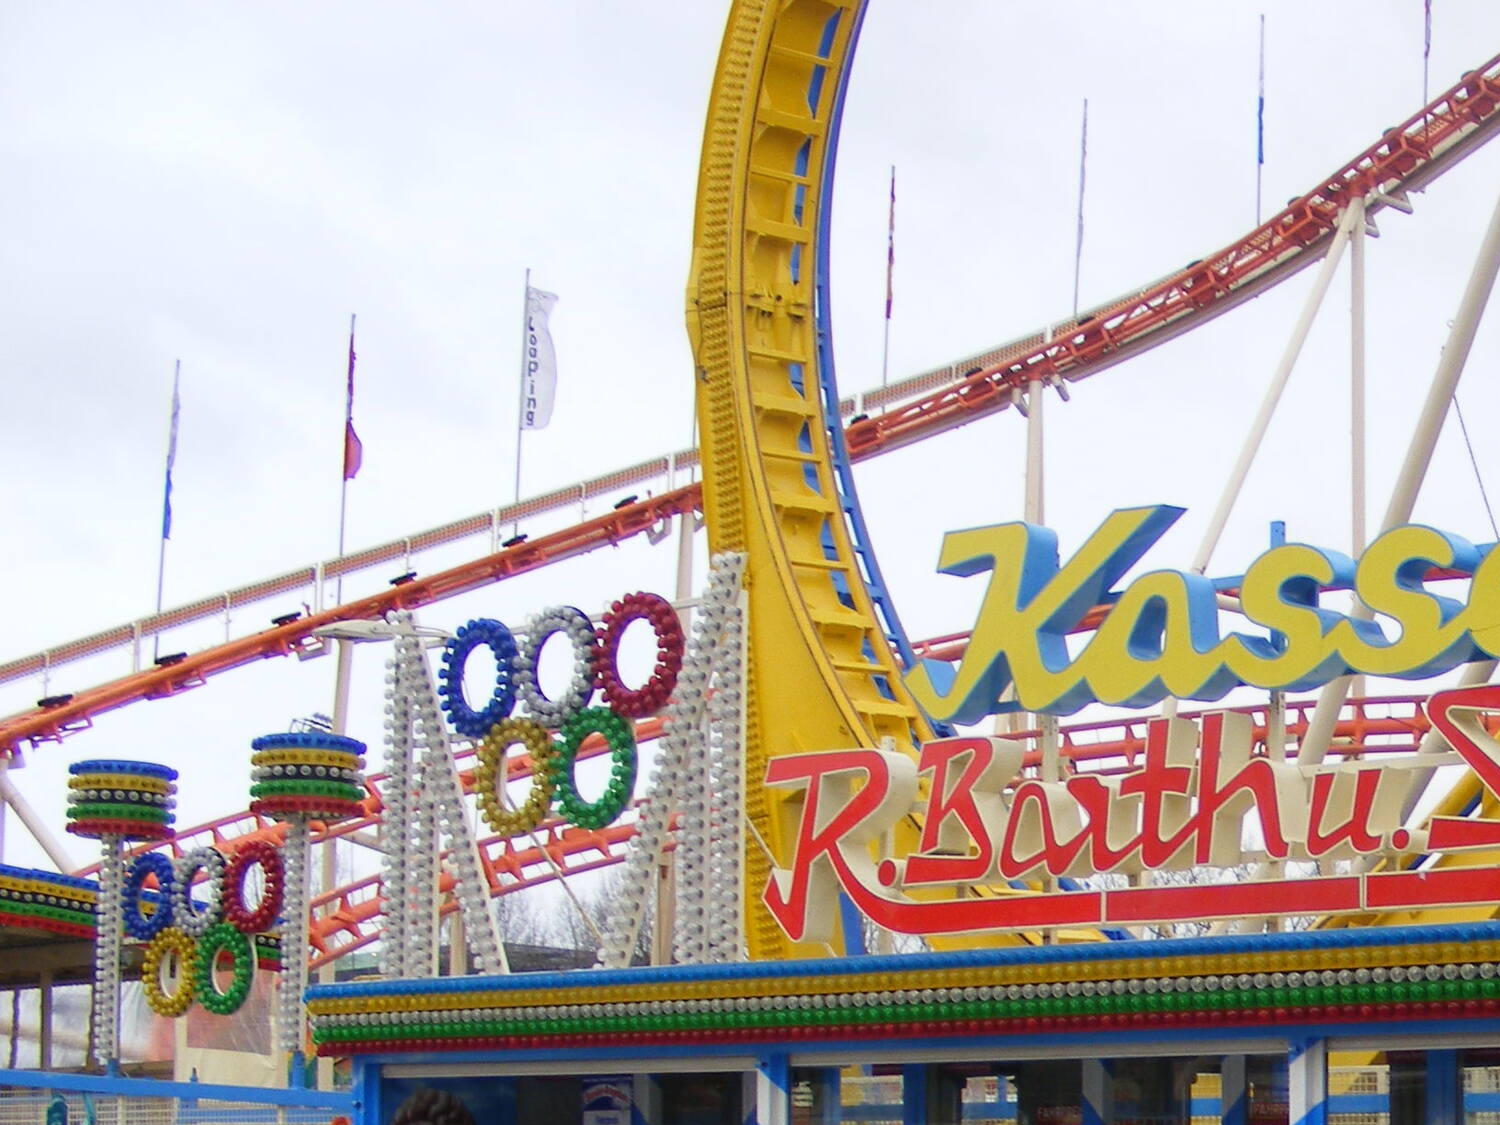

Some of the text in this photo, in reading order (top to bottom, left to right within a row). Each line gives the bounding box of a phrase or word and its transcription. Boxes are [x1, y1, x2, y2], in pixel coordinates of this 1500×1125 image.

[526, 316, 539, 427] Looping
[761, 746, 912, 944] R.
[900, 708, 1302, 886] Barth
[1305, 765, 1411, 857] u.
